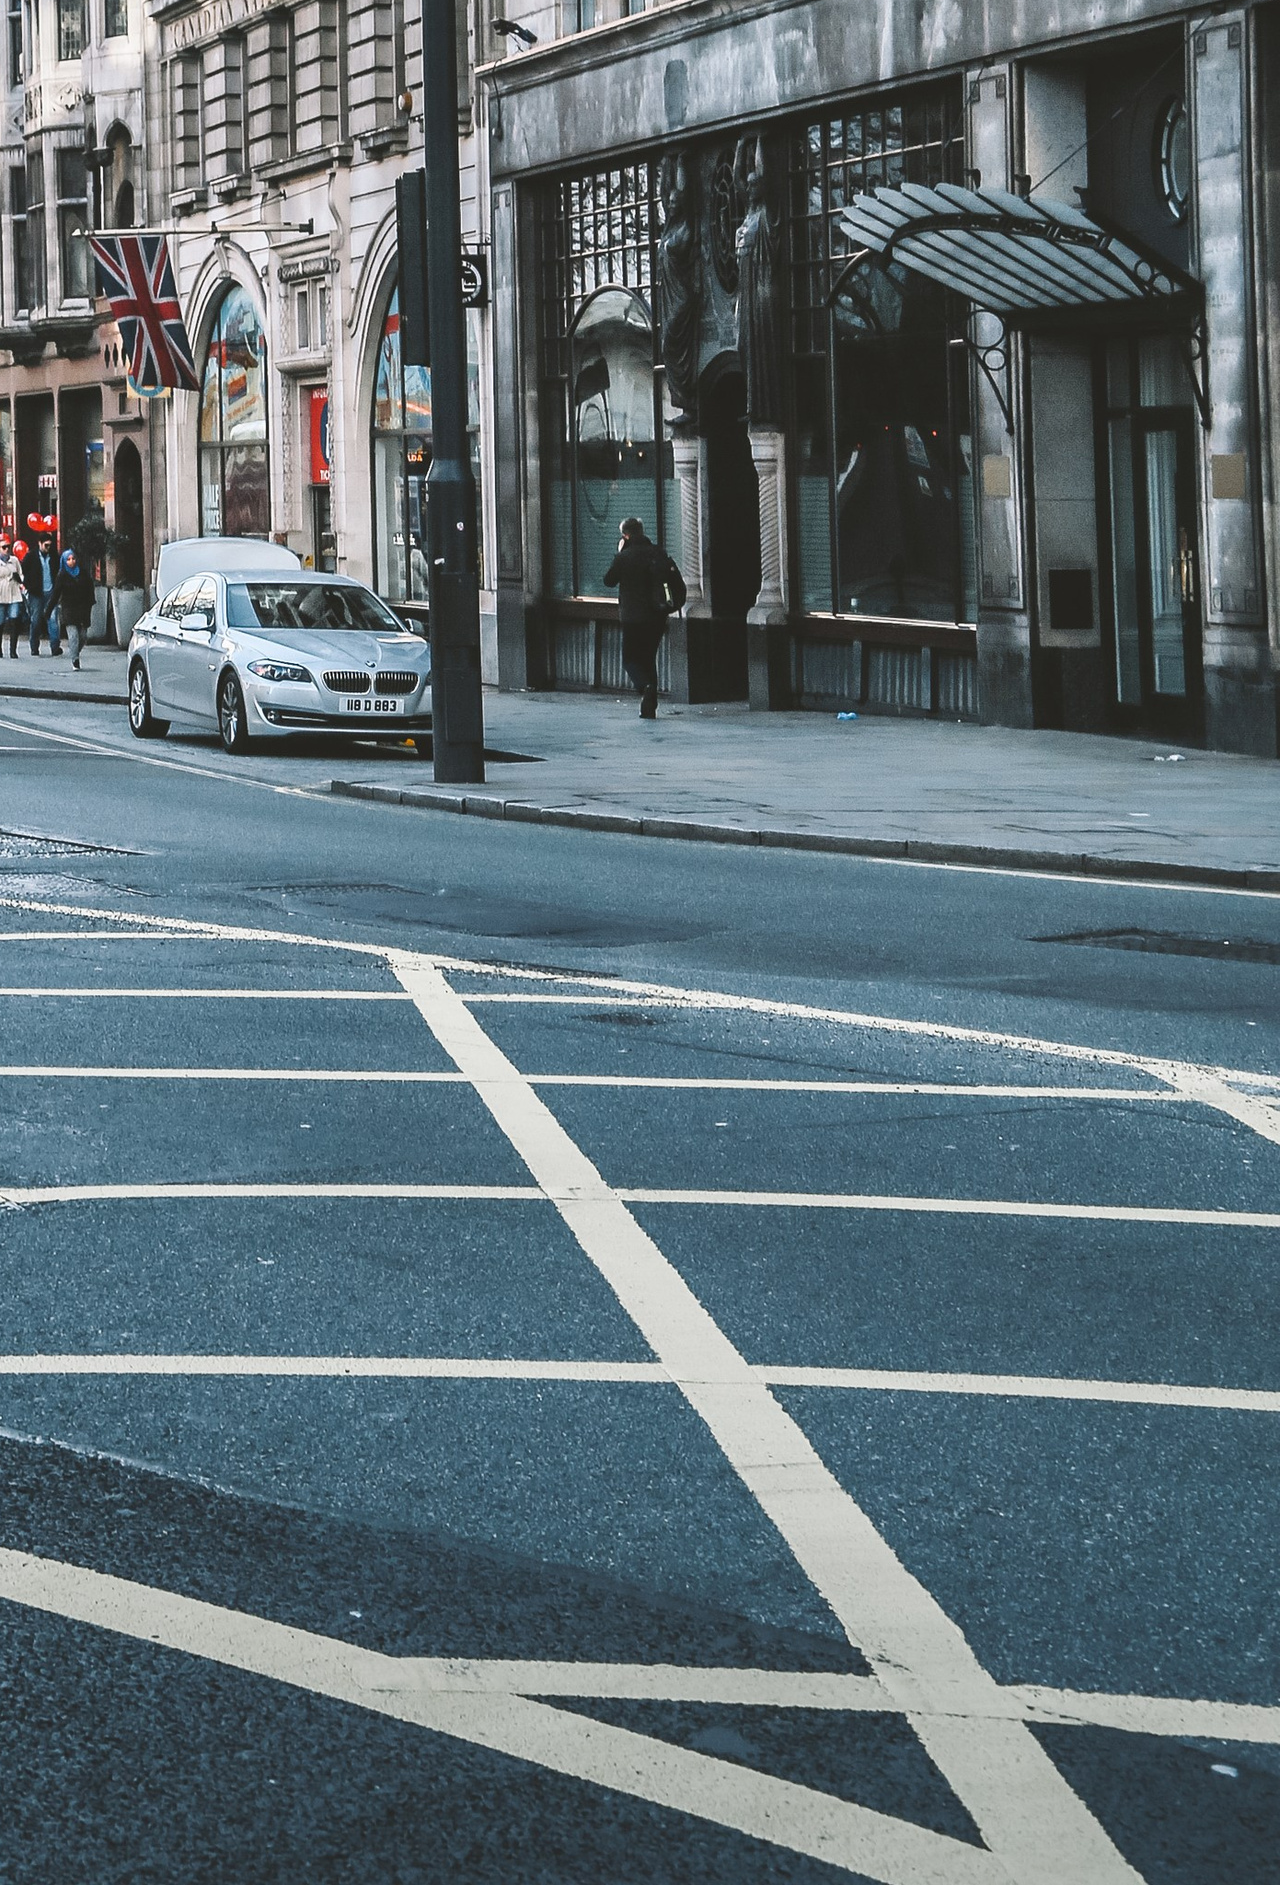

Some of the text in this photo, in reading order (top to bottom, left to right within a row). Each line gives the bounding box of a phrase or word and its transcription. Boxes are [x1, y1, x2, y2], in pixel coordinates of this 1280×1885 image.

[347, 699, 397, 712] 118 D 883
